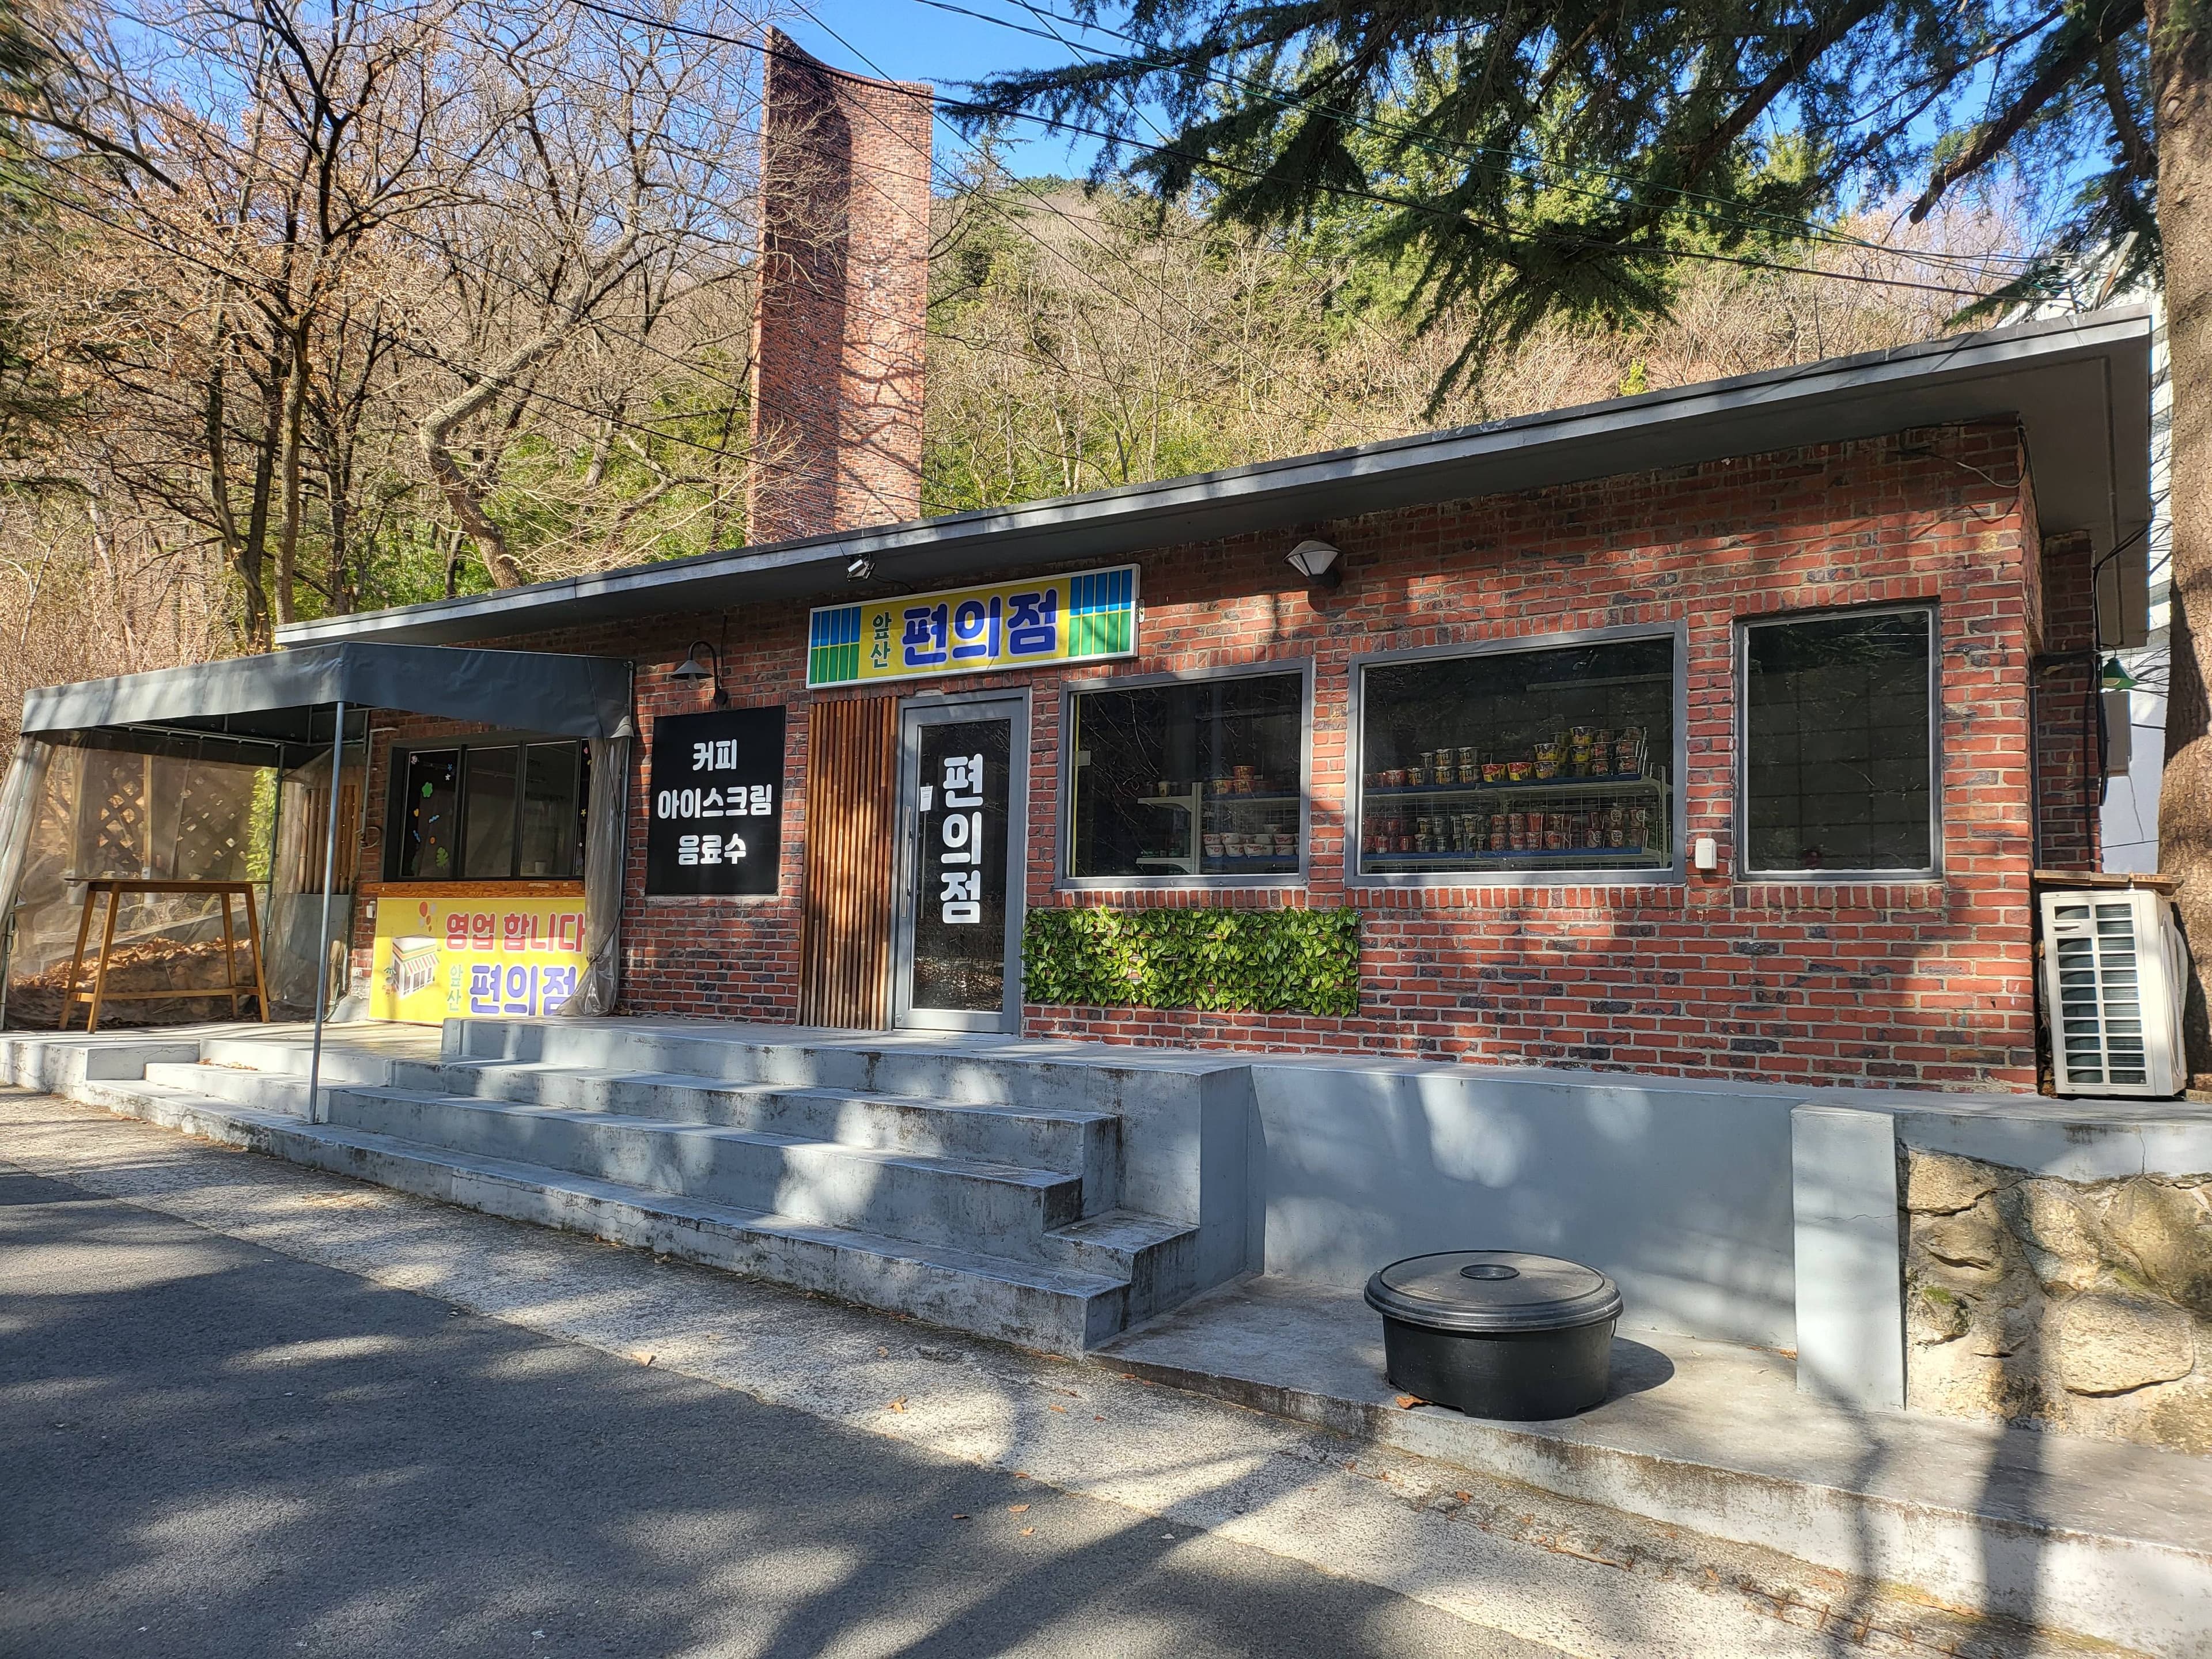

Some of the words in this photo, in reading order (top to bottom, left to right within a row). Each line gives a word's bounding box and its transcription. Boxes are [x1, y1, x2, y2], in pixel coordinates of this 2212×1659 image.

[870, 612, 892, 668] 앞산
[902, 589, 1057, 666] 편의점
[693, 739, 737, 771] 커피
[658, 784, 772, 819] 아이스크림
[679, 833, 747, 865] 음료수
[940, 753, 983, 924] 편의점
[446, 913, 495, 949] 영업
[503, 913, 585, 952] 합니다
[447, 965, 463, 1012] 앞산
[470, 965, 577, 1016] 편의점
